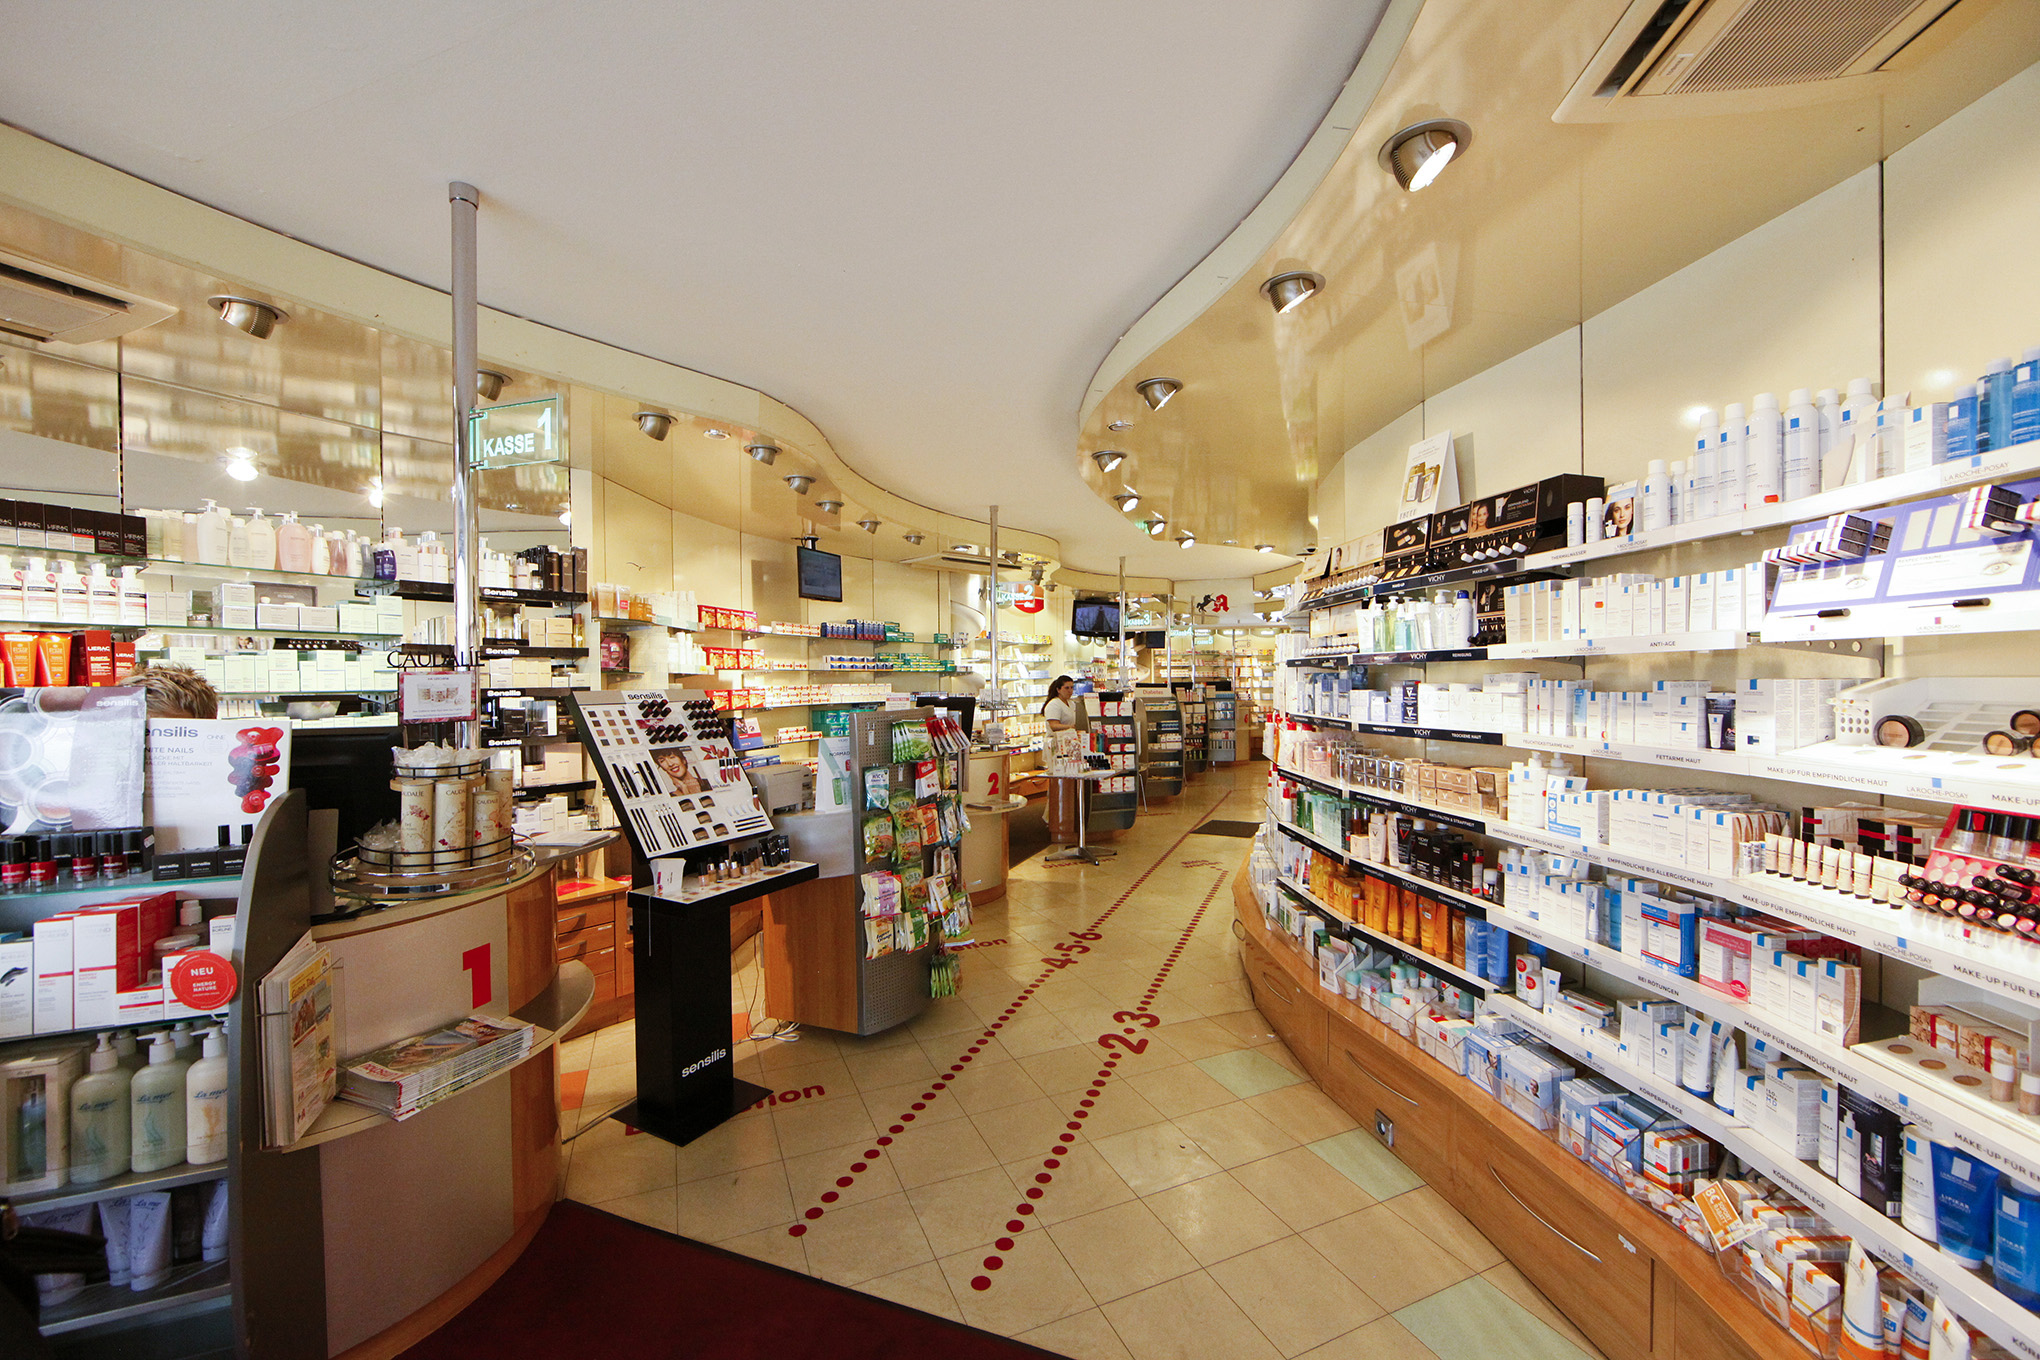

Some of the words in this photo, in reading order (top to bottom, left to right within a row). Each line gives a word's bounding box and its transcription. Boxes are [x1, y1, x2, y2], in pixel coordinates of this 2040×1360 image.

[482, 432, 535, 457] KASSE
[537, 407, 552, 450] 1
[1953, 461, 2008, 478] ROCHE-POSAY
[1551, 550, 1587, 561] THERMALWASSER
[1427, 573, 1445, 582] VICHY
[1024, 584, 1035, 600] 2
[1142, 614, 1150, 625] 3
[1650, 640, 1676, 648] ANTI-AGE
[96, 699, 140, 707] sensilis
[627, 692, 664, 700] sensilis
[1413, 728, 1431, 736] VICHY
[1656, 754, 1684, 763] FETTARME
[1685, 757, 1701, 765] HAUT
[987, 772, 999, 796] 2
[1767, 766, 1796, 776] MAKE-UP
[1797, 768, 1811, 778] FÜR
[1812, 772, 1866, 785] EMPFINDLICHE
[1866, 779, 1888, 787] HAUT
[1915, 787, 1969, 800] ROCHE-POSAY
[1401, 804, 1418, 814] VICHY
[1607, 857, 1645, 870] EMPFINDLICHE
[1645, 866, 1656, 874] BIS
[1656, 868, 1695, 884] ALLERGISCHE
[1696, 879, 1714, 888] HAUT
[1401, 879, 1419, 891] VICHY
[1742, 894, 1770, 907] MAKE-UP
[1770, 902, 1784, 913] FÜR
[1784, 907, 1835, 930] EMPFINDLICHE
[1836, 926, 1857, 937] HAUT
[1069, 932, 1103, 941] 6
[1530, 932, 1543, 941] HAUT
[1053, 943, 1091, 954] 5
[1881, 941, 1932, 964] ROCHE-POSAY
[1041, 958, 1079, 969] 4
[1402, 952, 1418, 964] VICHY
[191, 966, 214, 977] NEU
[462, 942, 492, 1010] 1
[1953, 963, 2001, 985] MAKE-UP
[2003, 979, 2026, 994] FÜR
[193, 985, 217, 993] NATURE
[1638, 975, 1648, 984] BEI
[1648, 977, 1680, 997] RÖTUNGEN
[1112, 1011, 1161, 1028] 3
[1537, 1027, 1553, 1041] PFLEGE
[1098, 1034, 1148, 1055] 2
[1744, 1020, 1771, 1039] MAKE-UP
[1772, 1033, 1785, 1047] FÜR
[1786, 1043, 1836, 1074] EMPFINDLICHE
[1837, 1069, 1858, 1085] HAUT
[682, 1048, 727, 1078] sensilis
[194, 1090, 208, 1099] La
[1639, 1086, 1683, 1116] KÖRPERPFLEGE
[1882, 1096, 1933, 1126] ROCHE-POSAY
[1954, 1131, 2001, 1161] MAKE-UP
[2003, 1156, 2027, 1176] FÜR
[1772, 1169, 1826, 1211] KÖRPERPFLEGE
[1717, 1200, 1732, 1222] SOFORT
